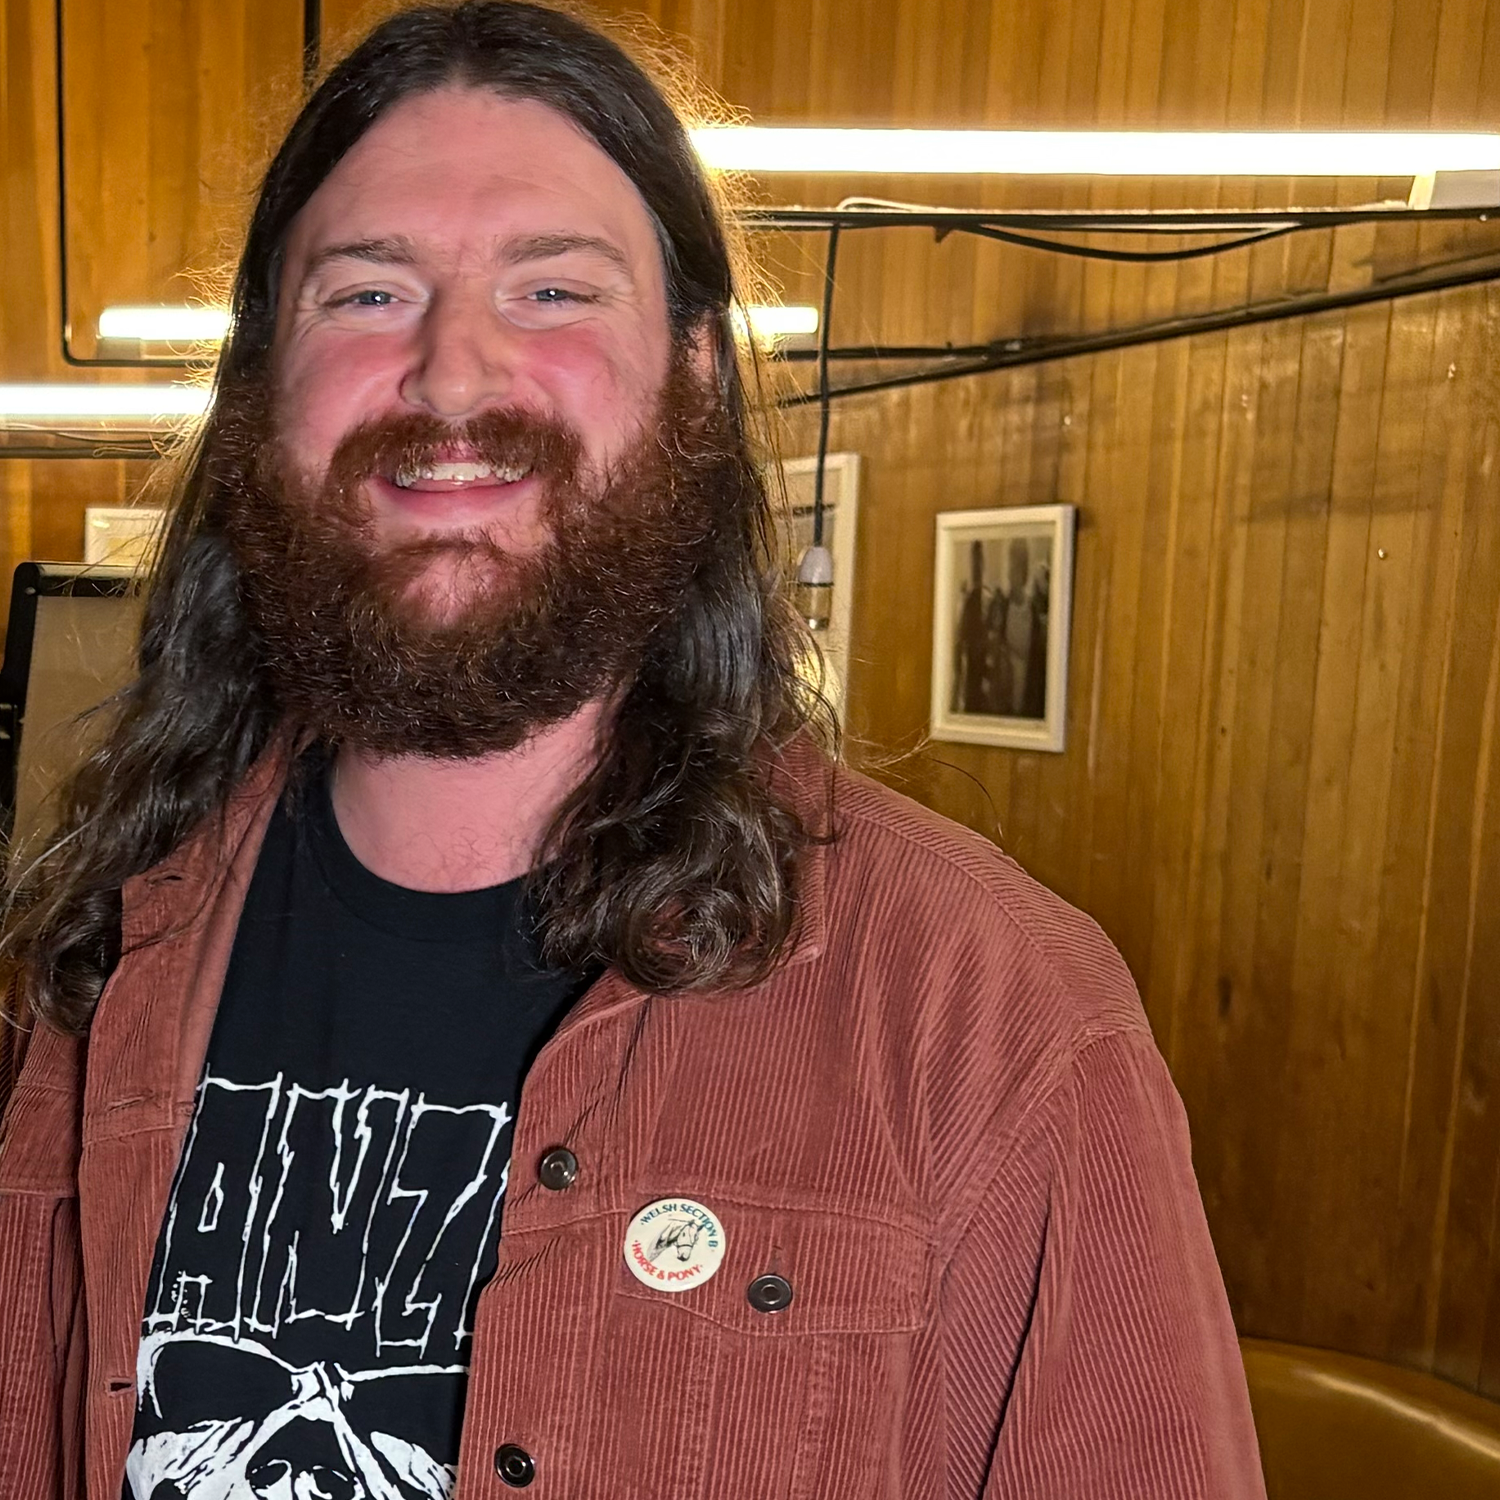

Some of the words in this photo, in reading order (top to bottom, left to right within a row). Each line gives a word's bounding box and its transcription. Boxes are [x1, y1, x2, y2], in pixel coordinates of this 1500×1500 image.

[143, 1063, 512, 1359] ANZ
[642, 1204, 677, 1224] WELSH
[680, 1204, 717, 1237] SECTION
[708, 1240, 718, 1248] B
[632, 1242, 656, 1275] HORSE
[656, 1270, 666, 1281] &
[667, 1265, 701, 1280] PONY
